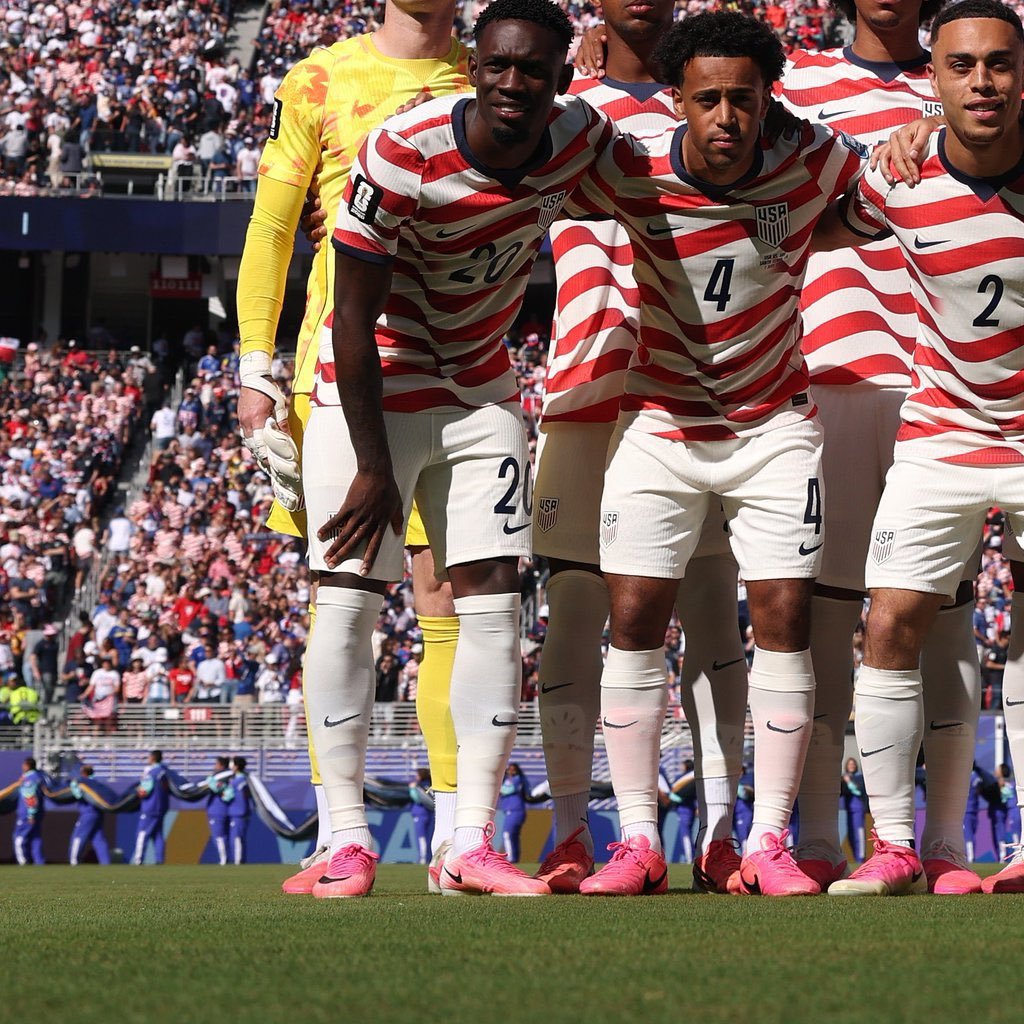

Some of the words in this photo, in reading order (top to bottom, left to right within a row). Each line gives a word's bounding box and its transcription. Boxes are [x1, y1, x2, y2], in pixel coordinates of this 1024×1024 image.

[925, 103, 941, 117] US
[542, 191, 565, 209] USA
[757, 204, 787, 223] USA
[448, 241, 523, 284] 20
[703, 259, 735, 311] 4
[972, 274, 1004, 327] 2
[494, 456, 533, 517] 20
[540, 498, 557, 513] USA
[803, 477, 822, 535] 4
[603, 513, 617, 527] USA
[875, 531, 894, 545] USA
